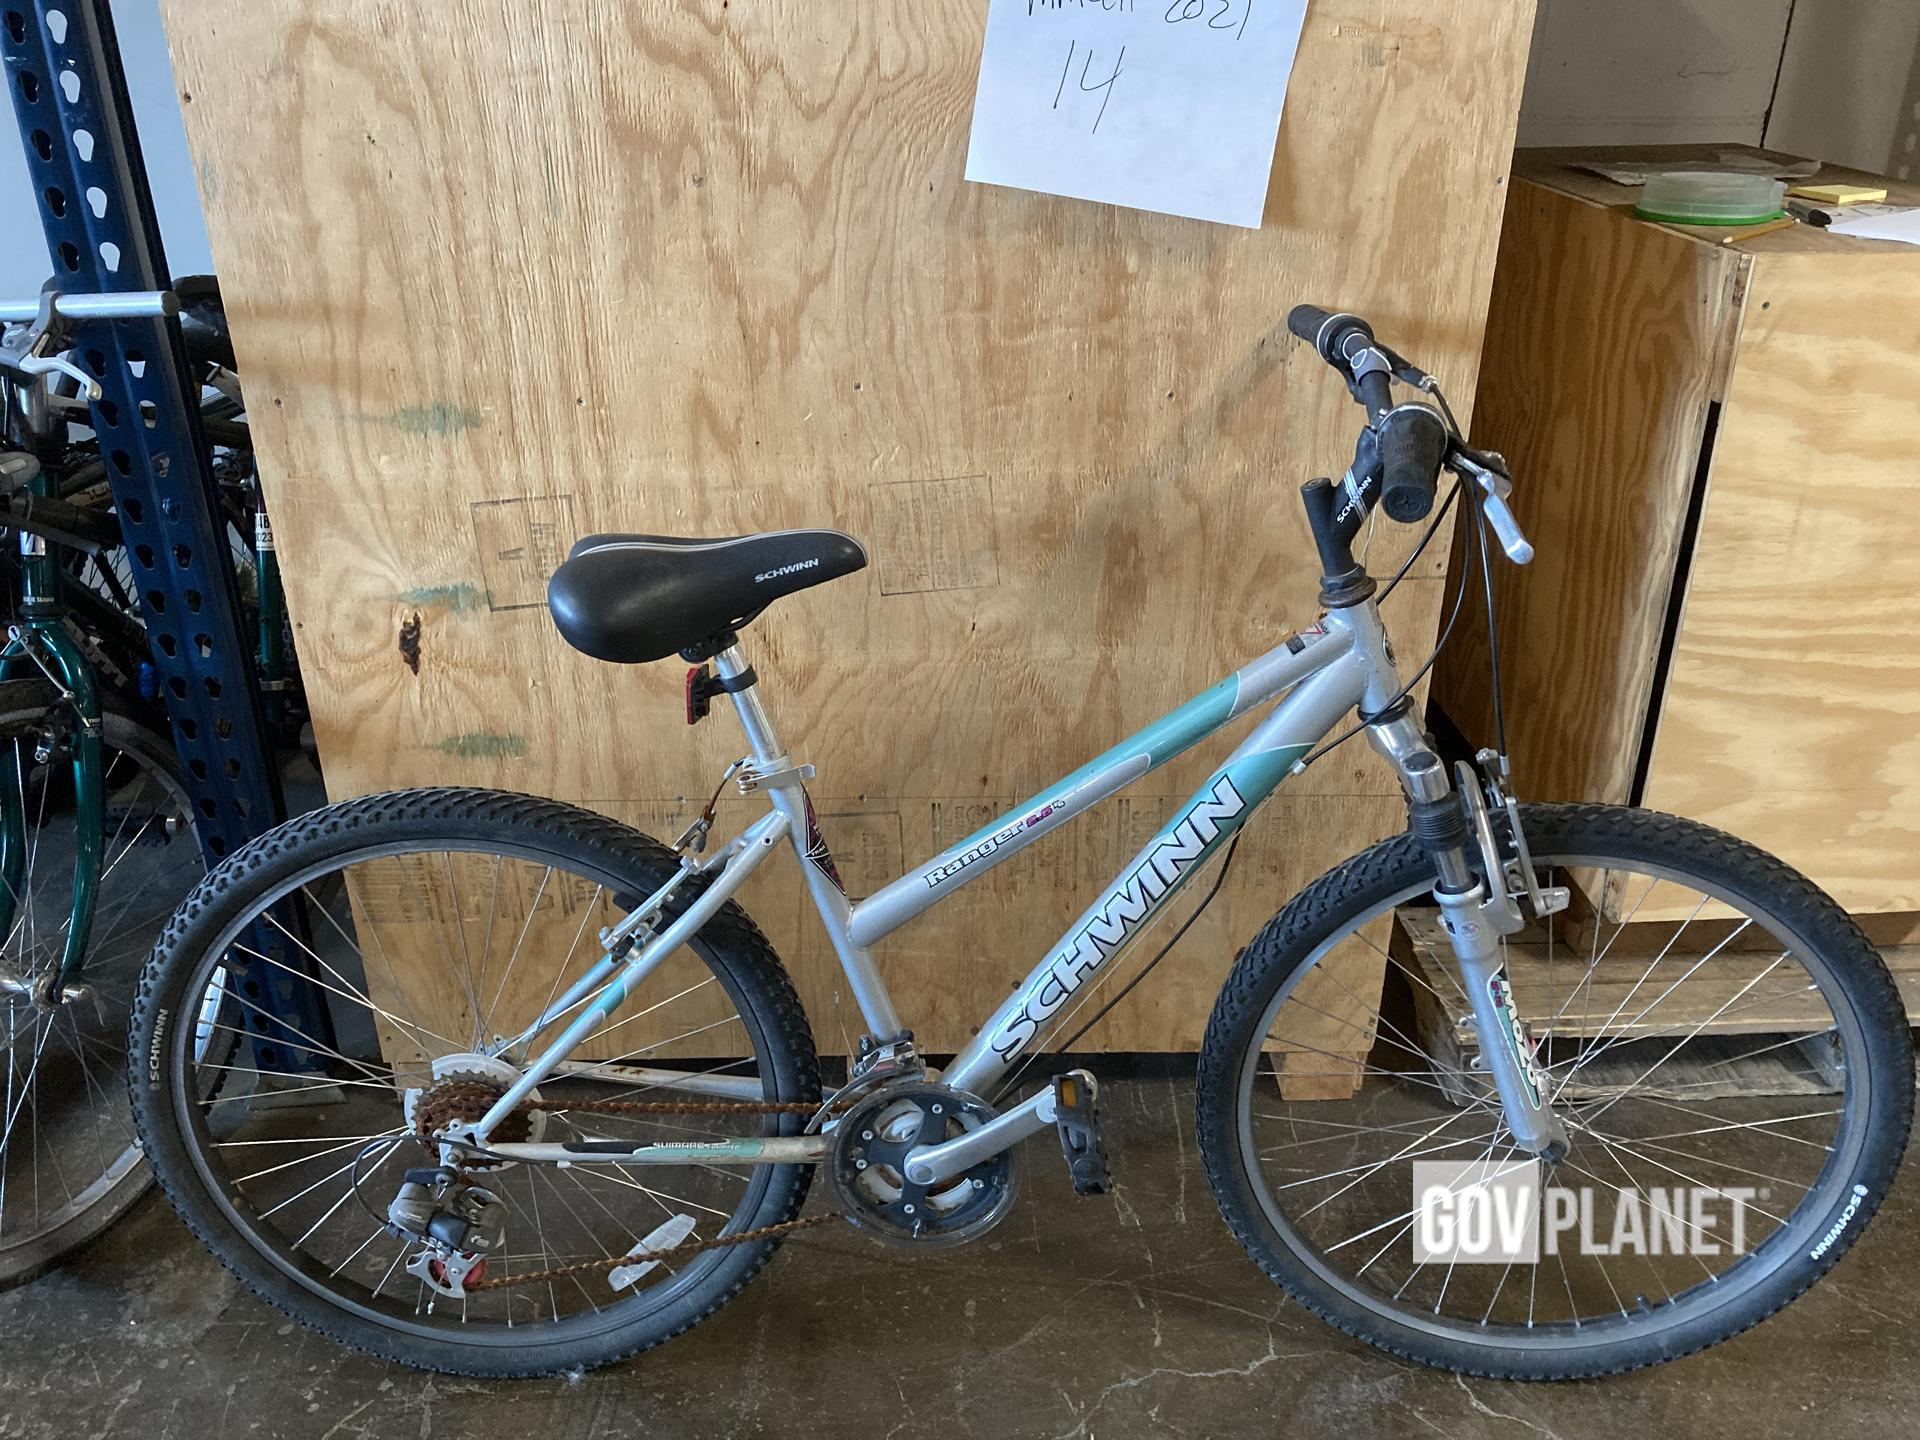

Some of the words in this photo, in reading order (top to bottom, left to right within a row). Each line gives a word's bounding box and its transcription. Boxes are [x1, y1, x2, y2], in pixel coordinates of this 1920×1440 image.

[1053, 40, 1126, 134] 14
[1337, 476, 1372, 524] SCHWINN
[754, 558, 819, 583] SCHWINN
[923, 821, 1024, 889] Ranger
[991, 773, 1248, 1064] SCHWINN
[149, 1008, 169, 1082] SCHWINN
[1500, 979, 1538, 1088] MOZO
[1810, 1194, 1862, 1261] SCHWINN
